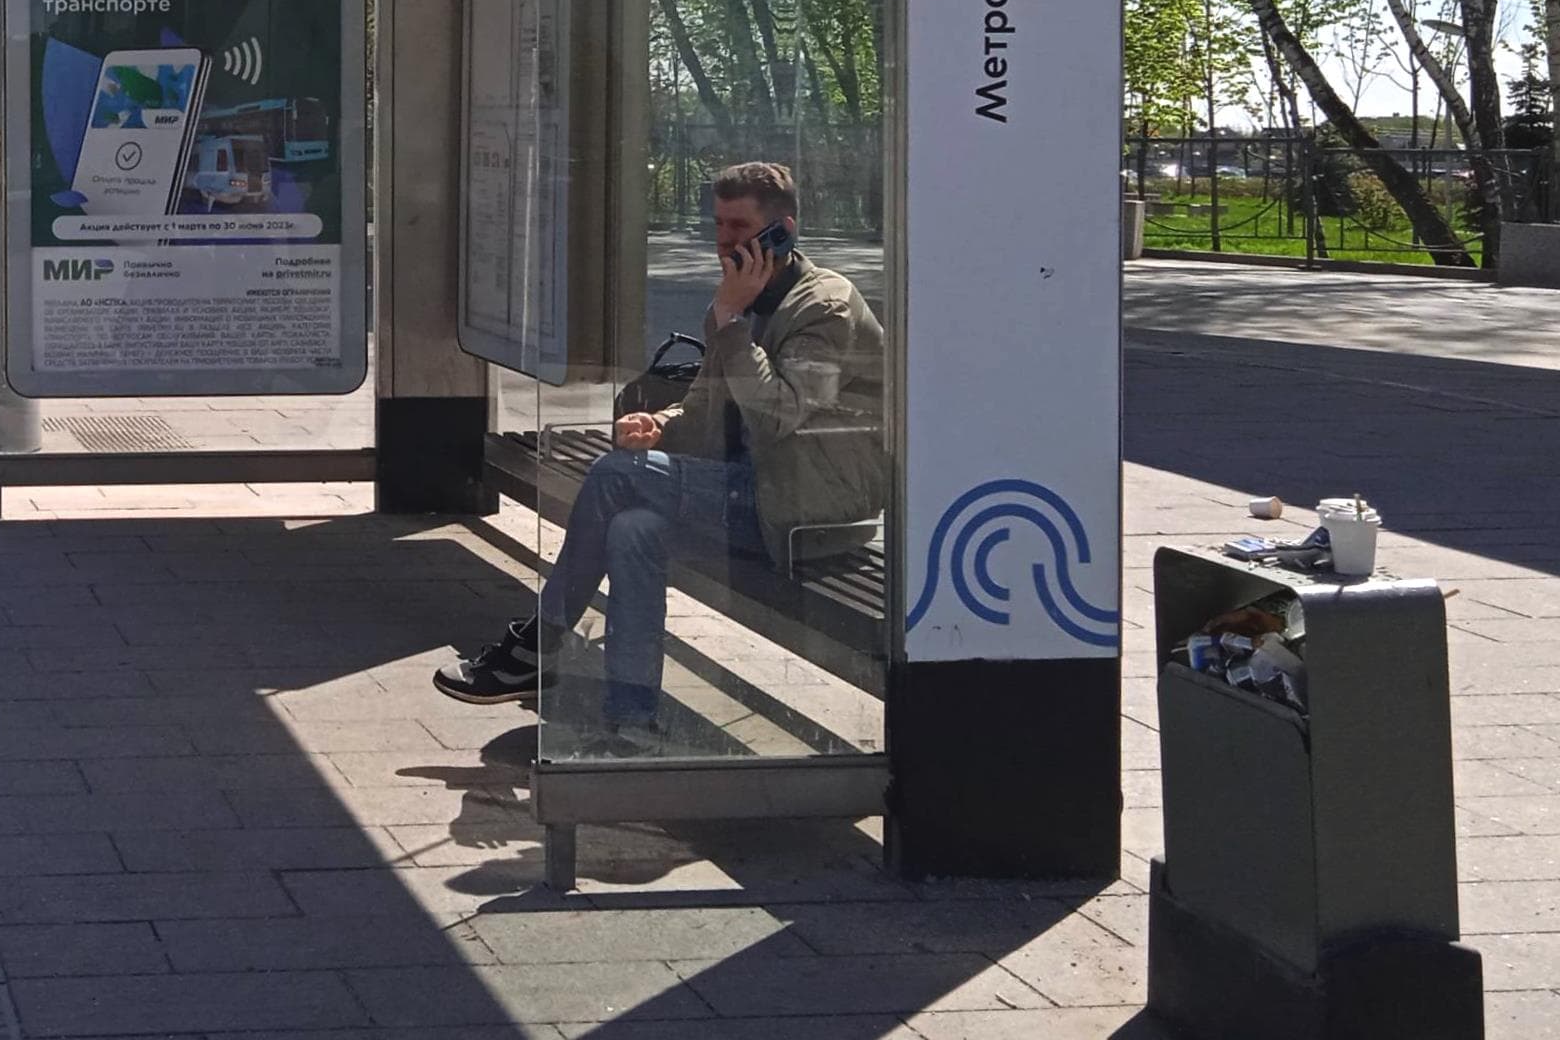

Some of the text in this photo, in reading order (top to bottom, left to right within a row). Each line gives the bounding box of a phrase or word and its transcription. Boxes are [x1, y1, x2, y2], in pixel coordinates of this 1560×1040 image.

[154, 115, 180, 125] МИР
[80, 223, 110, 233] Акция
[112, 222, 163, 233] действует
[178, 223, 207, 231] марта
[208, 223, 222, 231] по
[223, 222, 237, 231] 30
[43, 259, 115, 280] МИР
